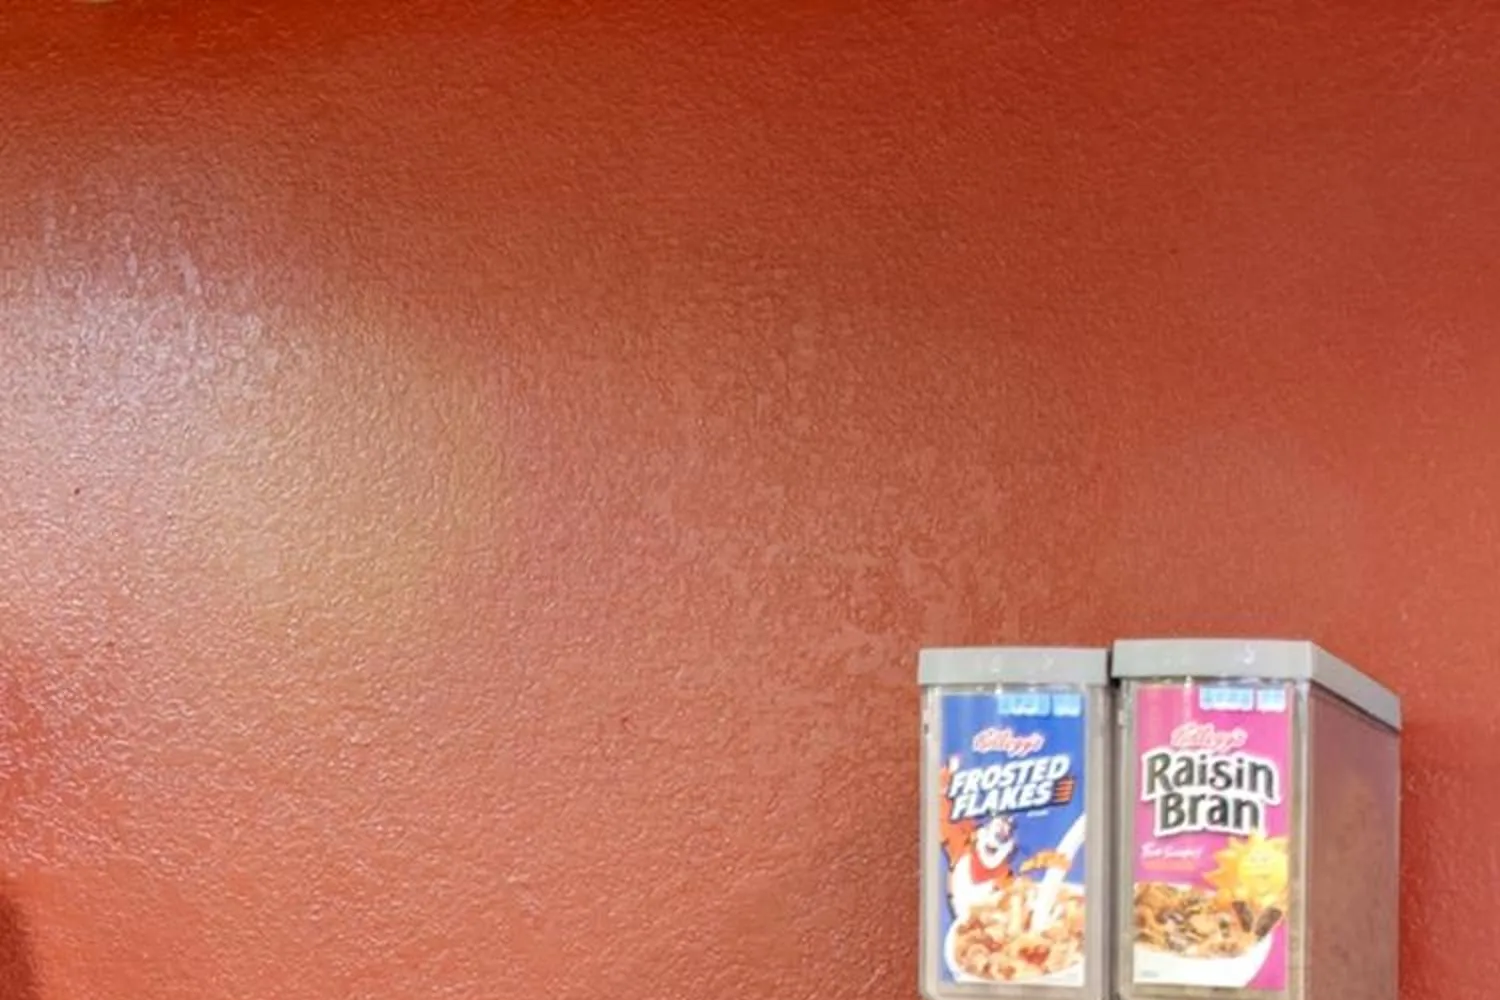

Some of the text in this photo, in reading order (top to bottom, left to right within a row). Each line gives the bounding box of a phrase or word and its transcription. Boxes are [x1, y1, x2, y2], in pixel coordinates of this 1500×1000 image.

[949, 754, 1071, 798] FROSTED
[1146, 750, 1276, 799] Raisin
[951, 779, 1053, 820] FLAKES
[1159, 790, 1260, 830] Bran
